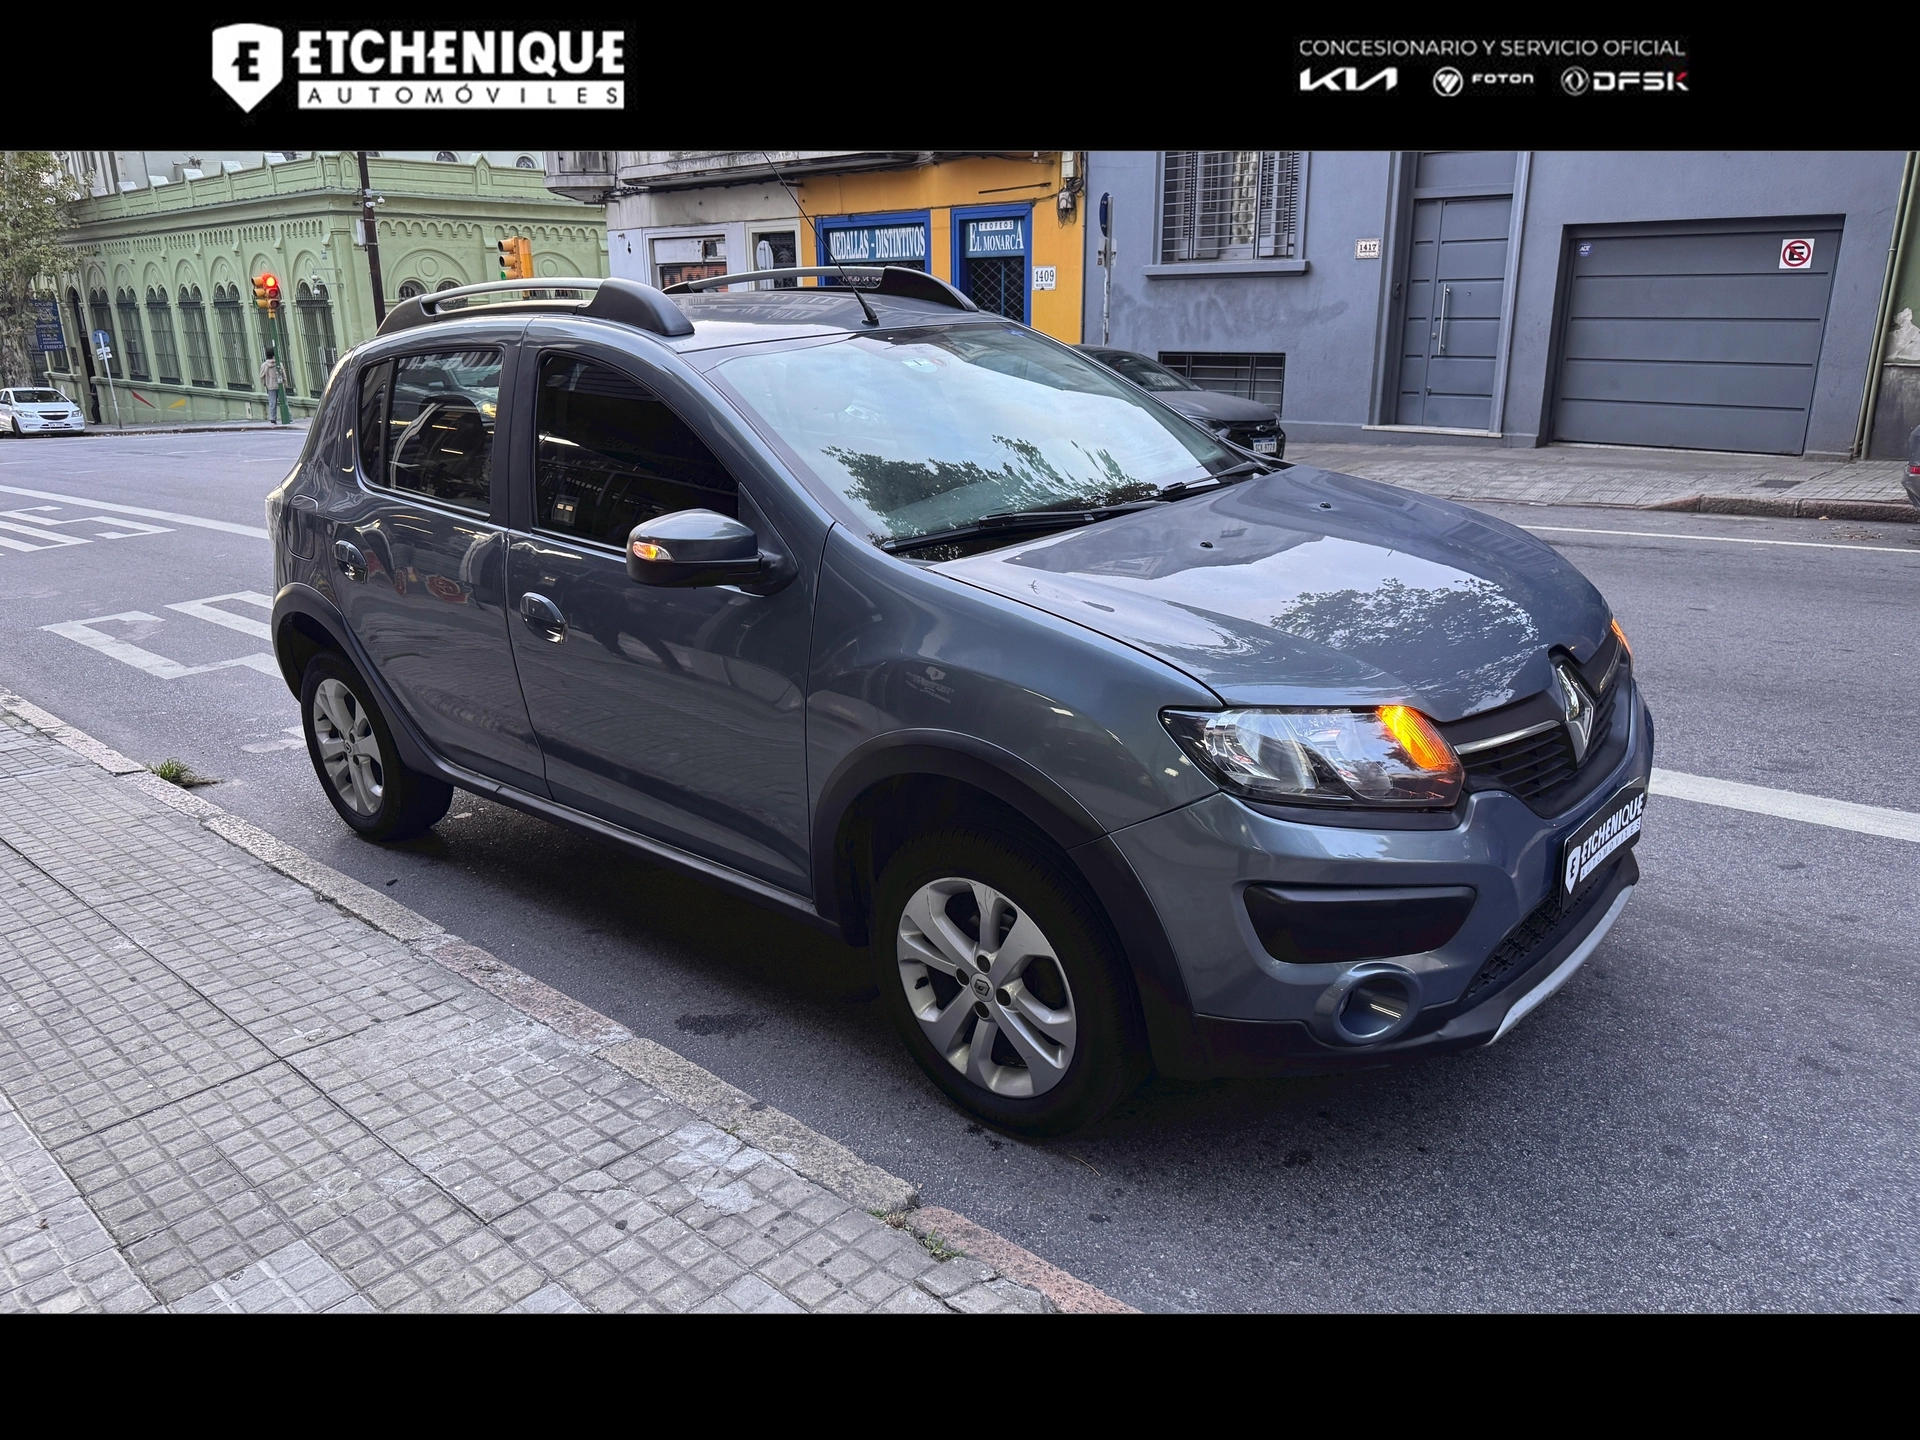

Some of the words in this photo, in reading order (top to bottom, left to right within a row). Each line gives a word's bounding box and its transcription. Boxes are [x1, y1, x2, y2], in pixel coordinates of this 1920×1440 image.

[980, 221, 1013, 230] TROFEOS
[983, 219, 1025, 251] MONARCA
[829, 229, 869, 260] MEDALLAS
[875, 226, 926, 259] DISTINTIVOS
[1360, 243, 1377, 251] 1417
[1035, 269, 1055, 282] 1409
[1581, 792, 1645, 865] ETCHENIQUE
